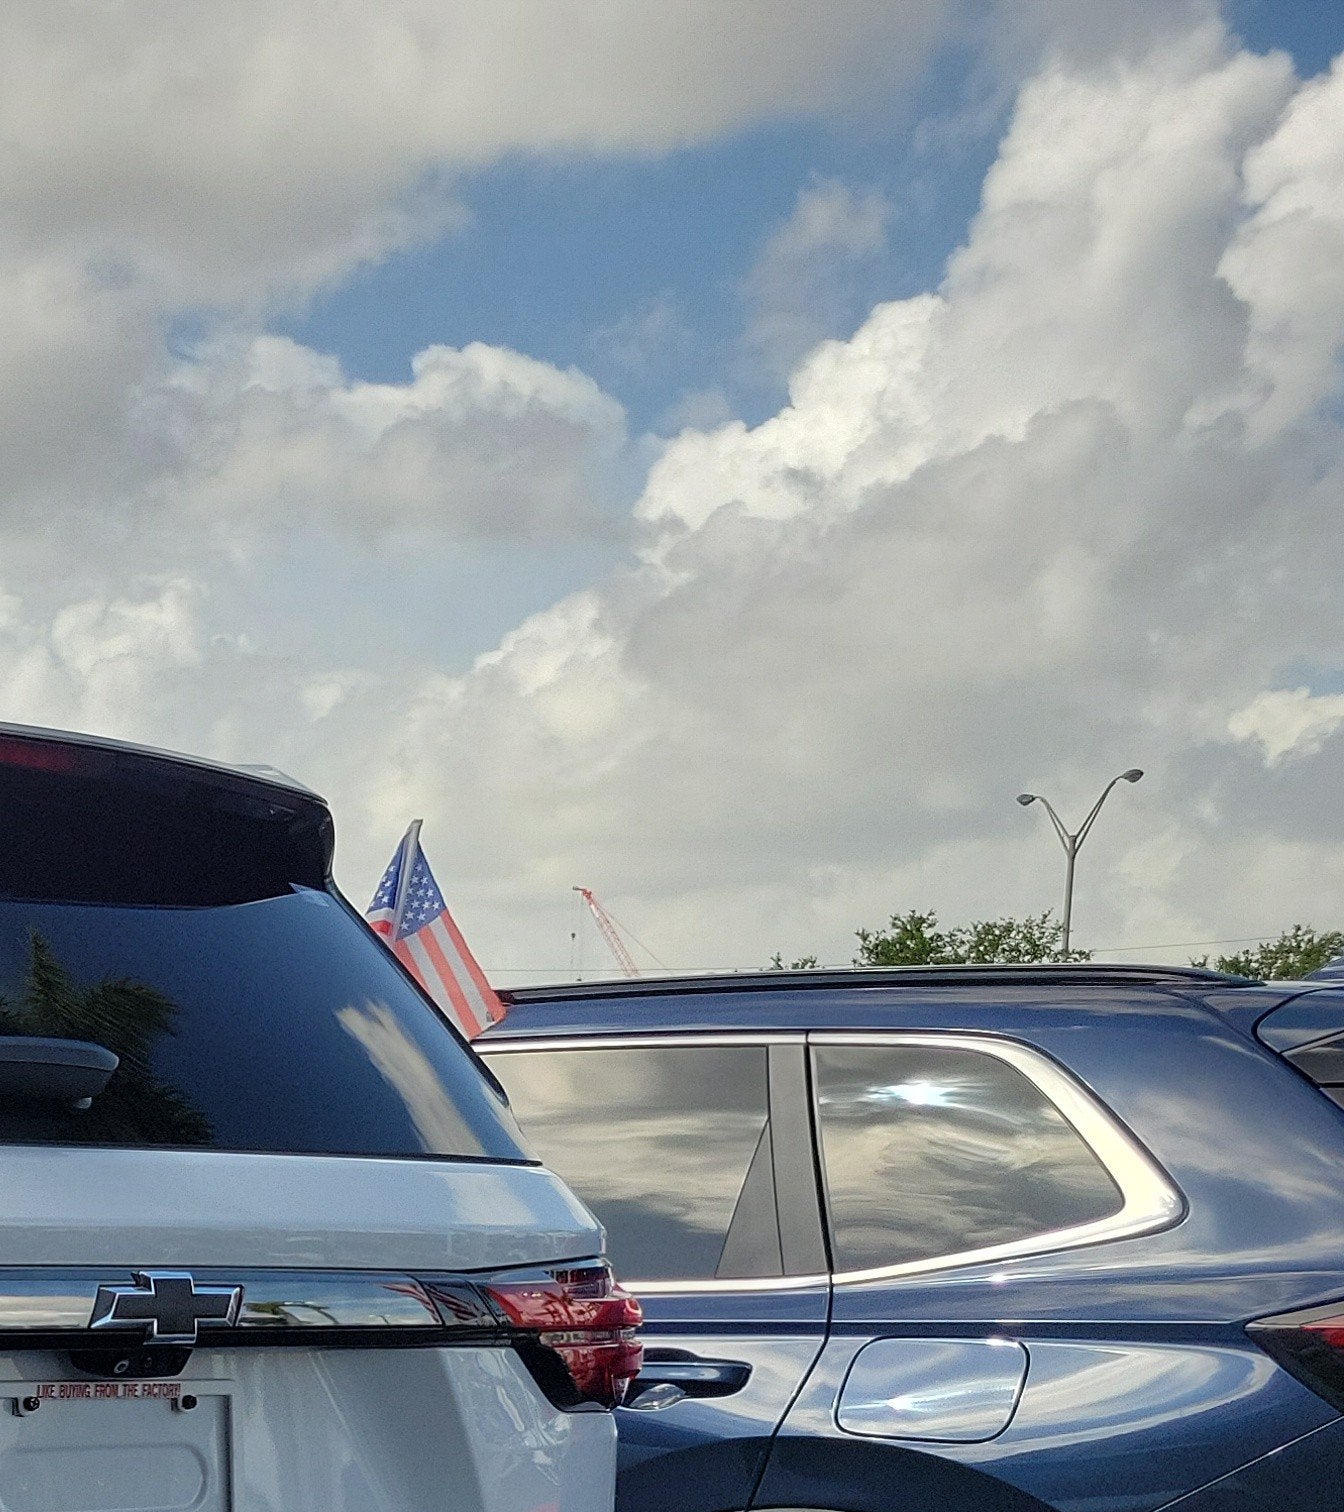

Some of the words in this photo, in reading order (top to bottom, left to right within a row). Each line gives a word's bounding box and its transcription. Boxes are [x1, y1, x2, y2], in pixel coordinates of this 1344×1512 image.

[37, 1384, 56, 1398] LIKE
[59, 1384, 91, 1398] BUYING
[94, 1383, 119, 1398] FROM
[122, 1383, 139, 1398] THE
